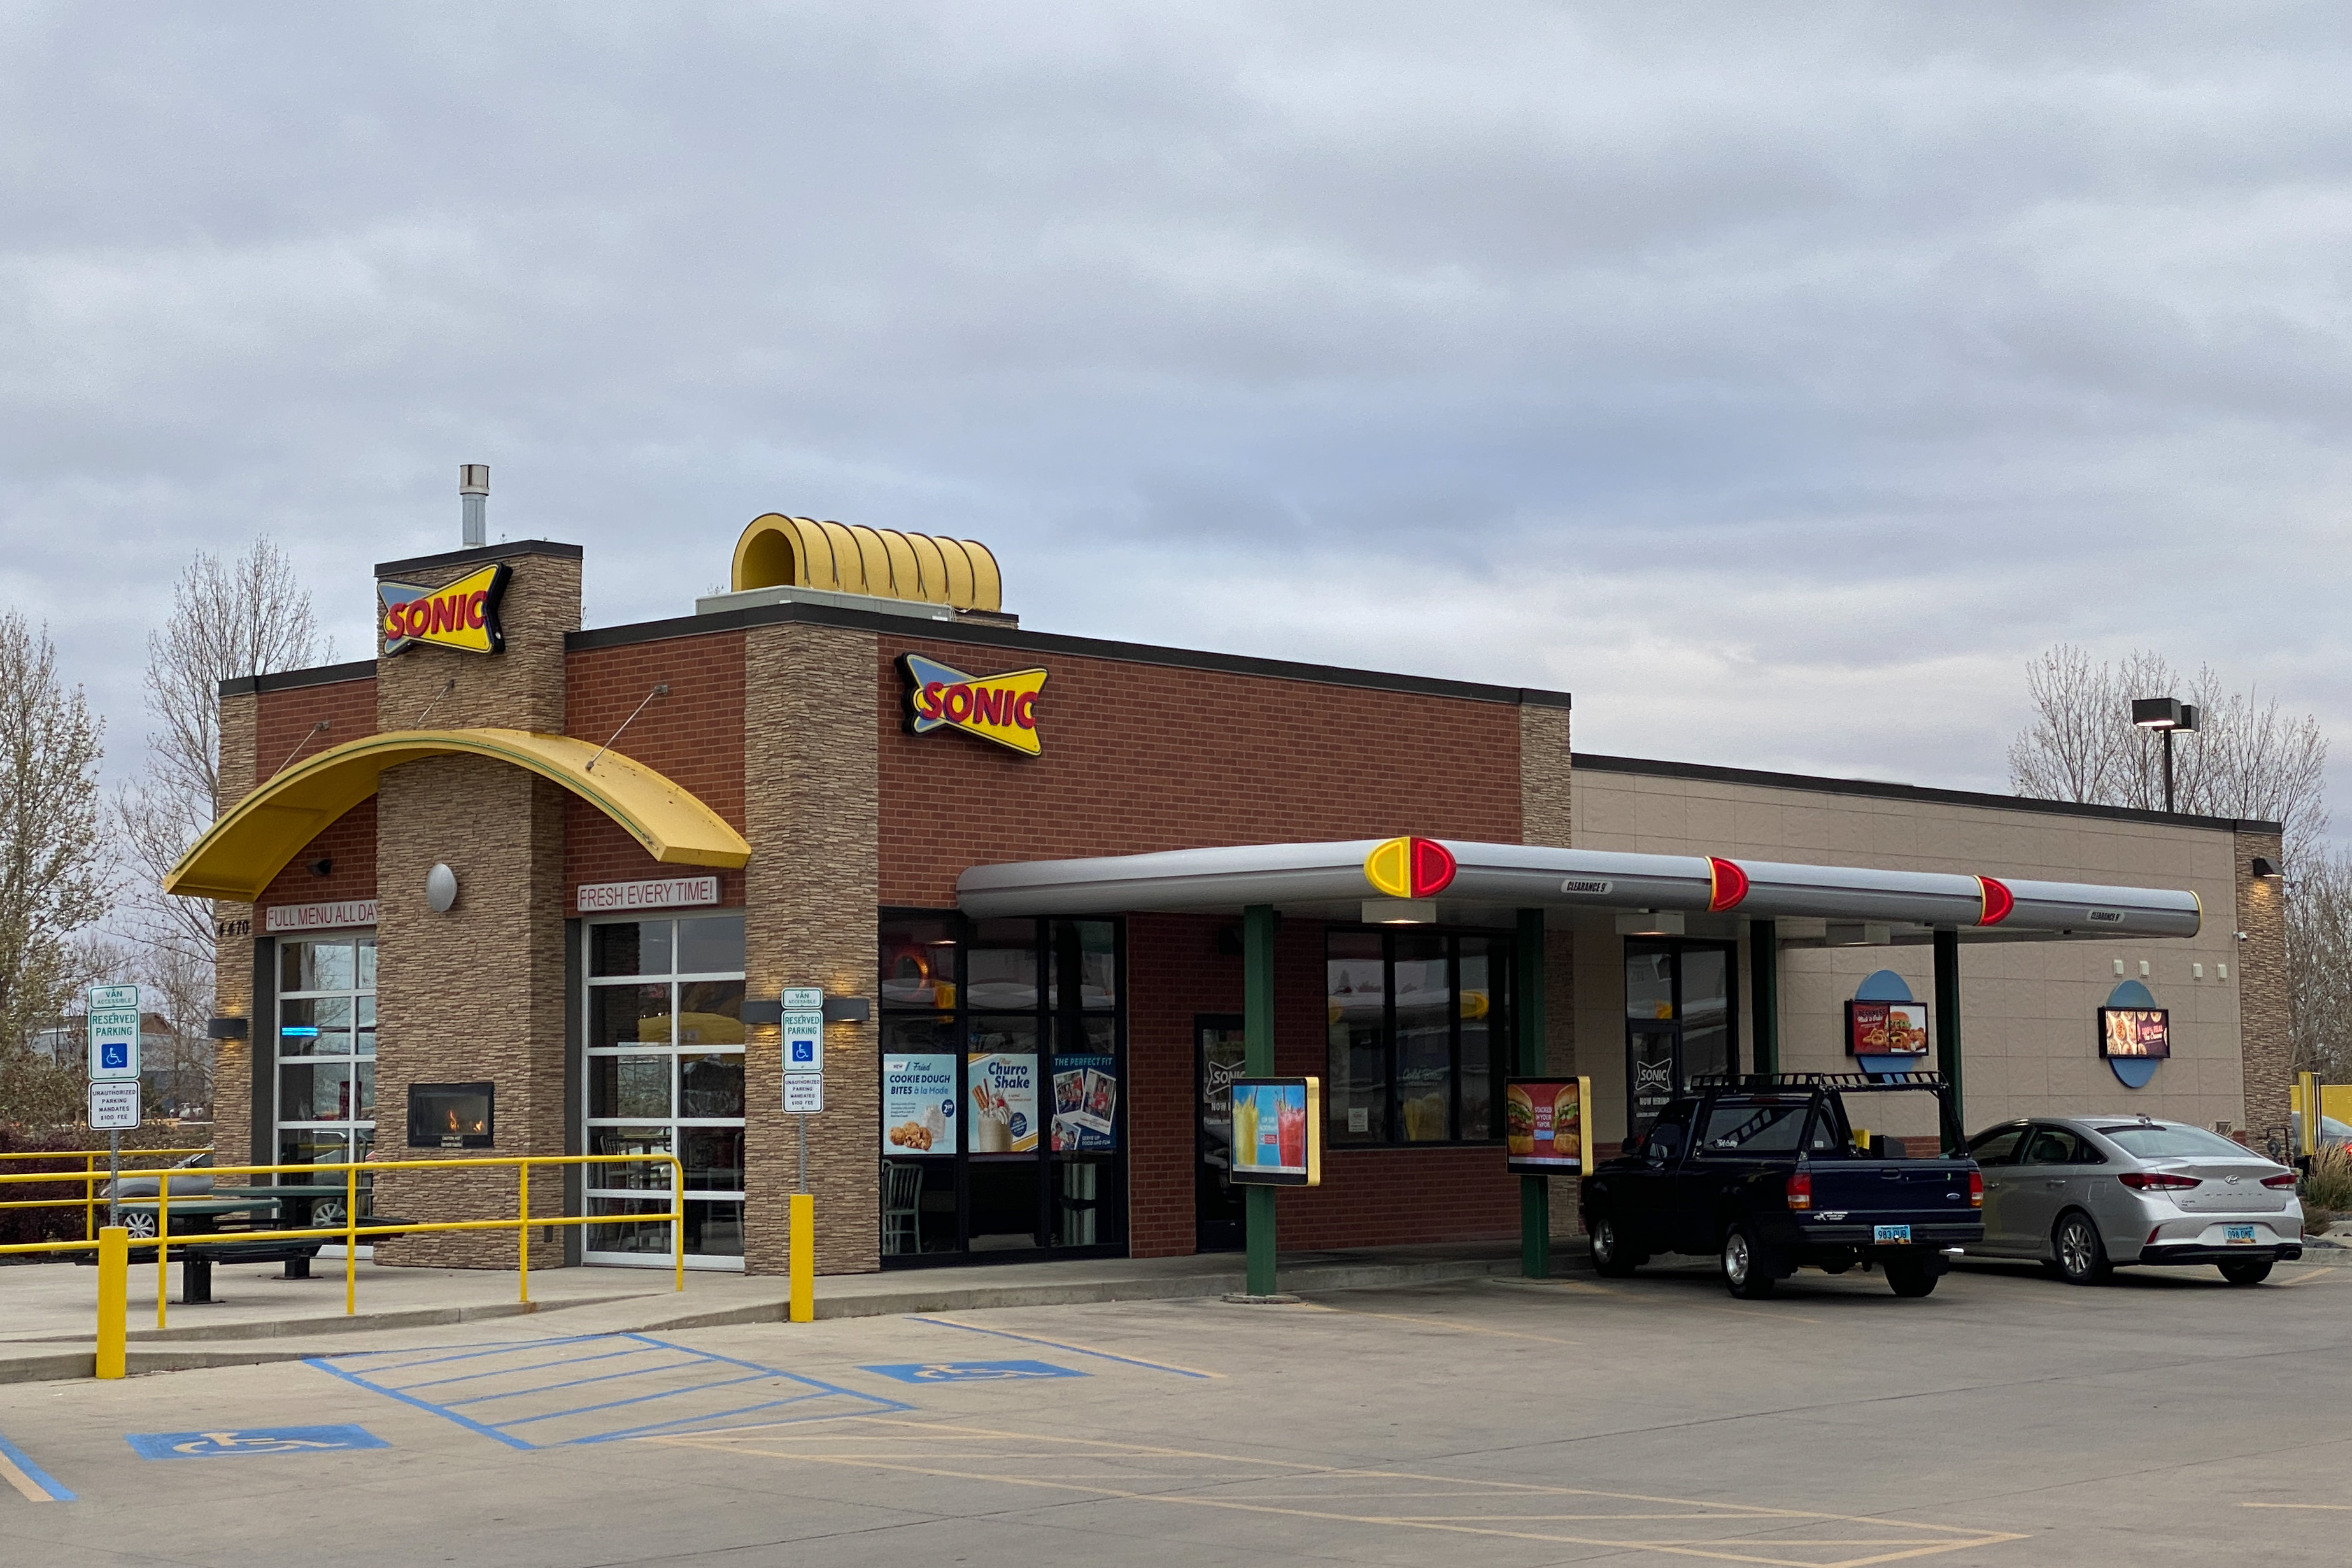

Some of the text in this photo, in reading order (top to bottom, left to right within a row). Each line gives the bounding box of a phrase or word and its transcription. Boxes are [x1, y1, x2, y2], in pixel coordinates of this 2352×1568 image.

[386, 590, 487, 641] SONIC
[918, 681, 1039, 730] SONIC
[1567, 881, 1601, 892] CLEARANCE
[579, 880, 713, 908] FRESH EVERY TIME!
[267, 907, 295, 928] FULL
[297, 905, 333, 925] MENU
[335, 905, 356, 922] ALL
[92, 1014, 136, 1024] RESERVED
[785, 1016, 819, 1024] RESERVED
[96, 1027, 132, 1036] PARKING
[788, 1026, 817, 1035] PARKING
[913, 1062, 931, 1071] Fried
[1054, 1057, 1113, 1066] THE PERFECT FIT
[988, 1062, 1028, 1075] Churro
[889, 1075, 951, 1084] COOKIE DOUGH
[1640, 1070, 1667, 1081] SONIC
[995, 1075, 1030, 1089] Shake
[891, 1086, 912, 1094] BITES
[929, 1086, 949, 1094] Mode
[1211, 1102, 1226, 1112] NOW
[1878, 1230, 1892, 1240] 983
